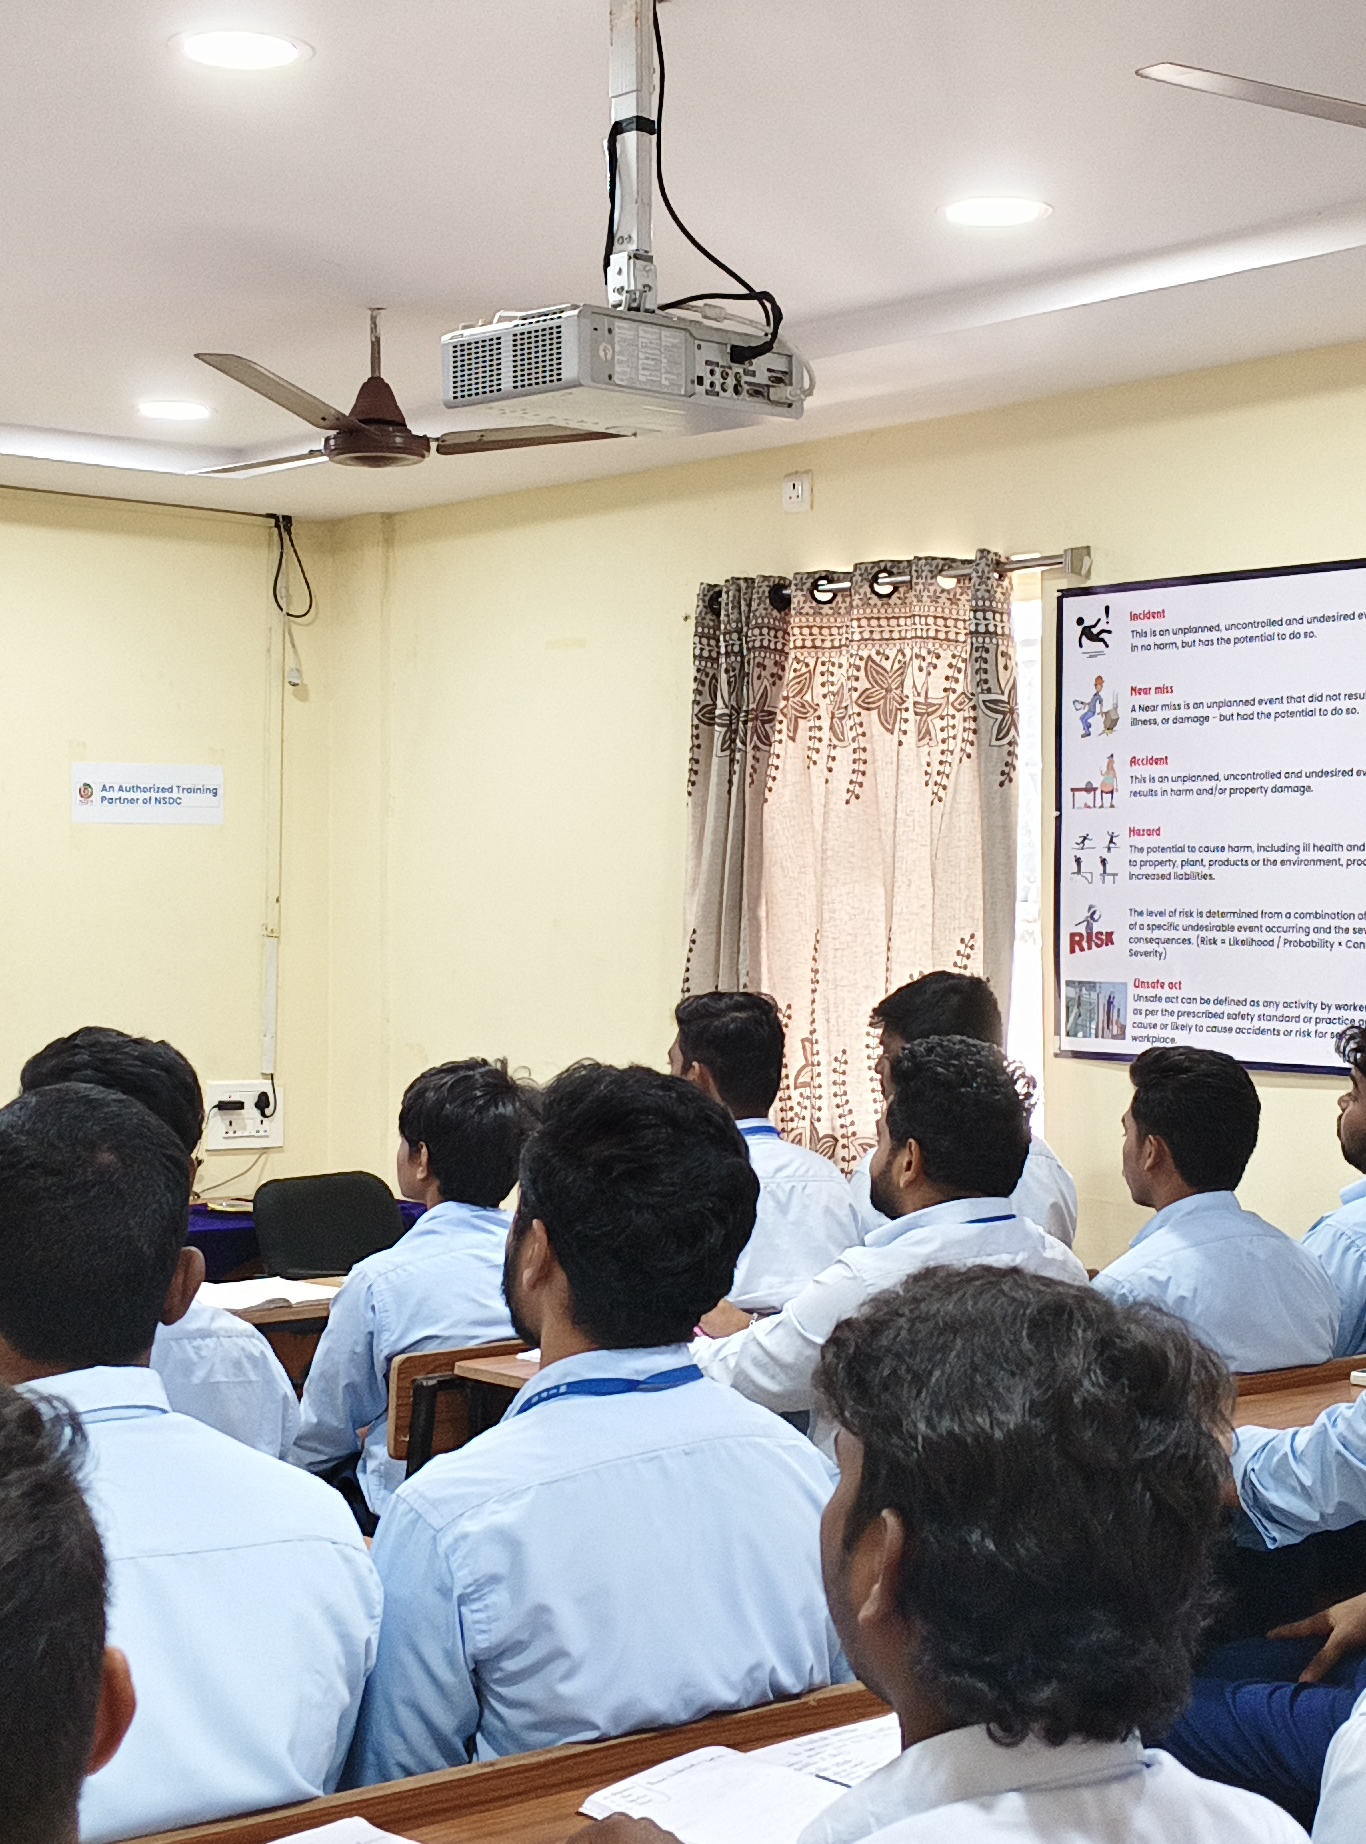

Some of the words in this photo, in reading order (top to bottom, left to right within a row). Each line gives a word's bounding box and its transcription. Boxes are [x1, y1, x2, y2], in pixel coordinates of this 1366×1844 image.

[1129, 608, 1165, 621] Incident
[1130, 628, 1147, 638] This
[1149, 627, 1157, 637] is
[1158, 628, 1170, 636] an
[1171, 623, 1221, 637] unplanned,
[1224, 616, 1283, 631] uncontrolled
[1284, 615, 1303, 626] and
[1306, 611, 1355, 624] undesired
[1130, 685, 1151, 696] Near
[1154, 683, 1173, 694] miss
[1129, 755, 1168, 767] Accident
[100, 783, 114, 792] An
[117, 783, 173, 793] Authorized
[175, 784, 217, 797] Training
[100, 795, 139, 804] Partner
[141, 795, 151, 804] of
[154, 796, 182, 805] NSDC
[1128, 907, 1144, 917] The
[1146, 908, 1166, 917] level
[1168, 908, 1176, 917] of
[1178, 908, 1194, 918] risk
[1196, 908, 1203, 918] is
[1205, 908, 1258, 918] determined
[1260, 909, 1282, 919] from
[1284, 911, 1291, 919] a
[1293, 909, 1355, 920] combination
[1357, 910, 1366, 920] of
[1069, 931, 1115, 954] RISK
[1133, 977, 1165, 989] Unsafe
[1167, 980, 1181, 990] act
